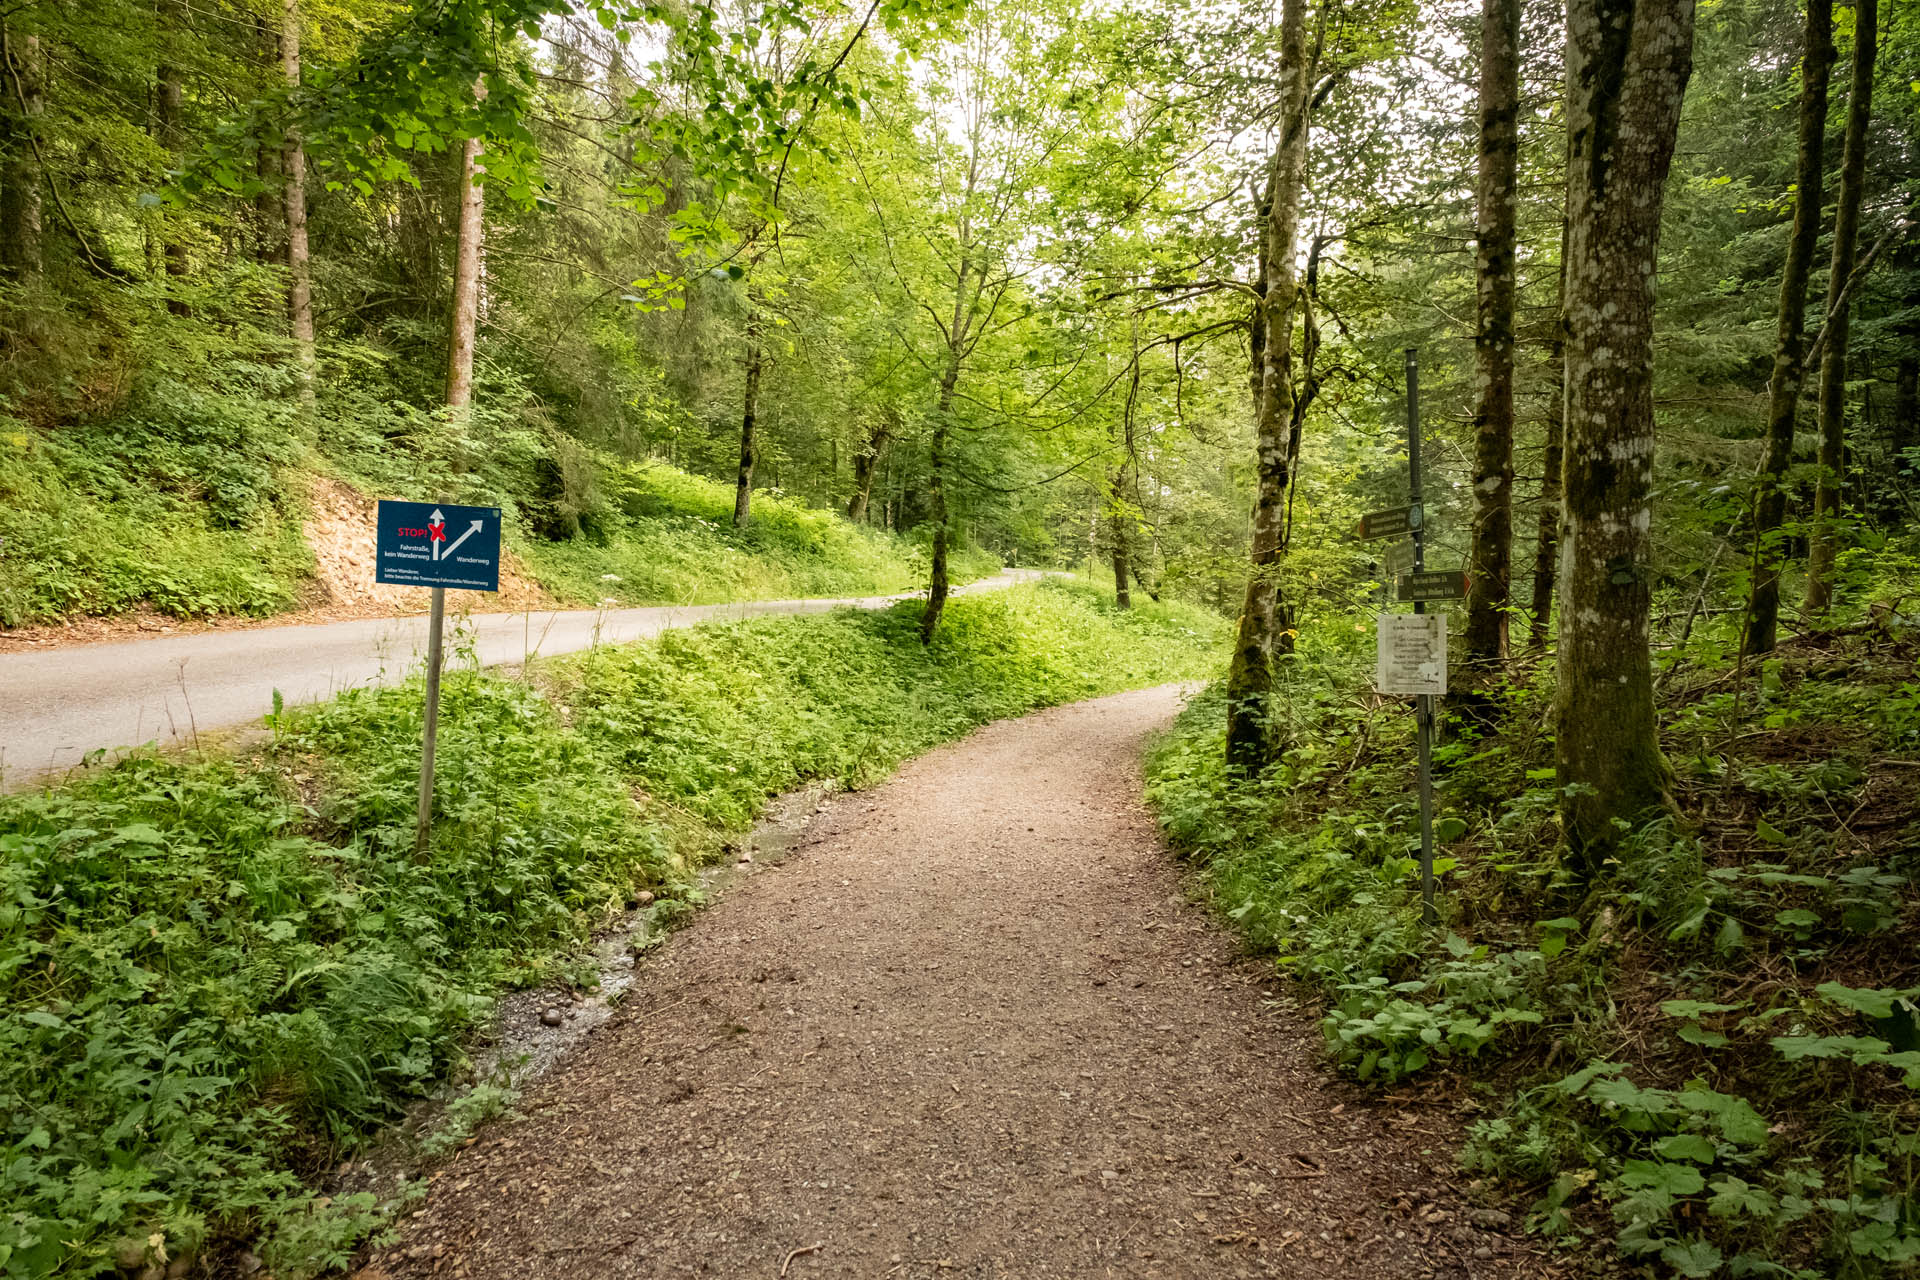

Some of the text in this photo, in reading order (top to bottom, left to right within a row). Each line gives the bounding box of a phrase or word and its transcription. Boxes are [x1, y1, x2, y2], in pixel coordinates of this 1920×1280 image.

[398, 528, 427, 537] STOP!
[400, 544, 429, 552] Fahrstraße,
[397, 552, 429, 560] Wanderweg
[457, 556, 489, 565] Wanderweg
